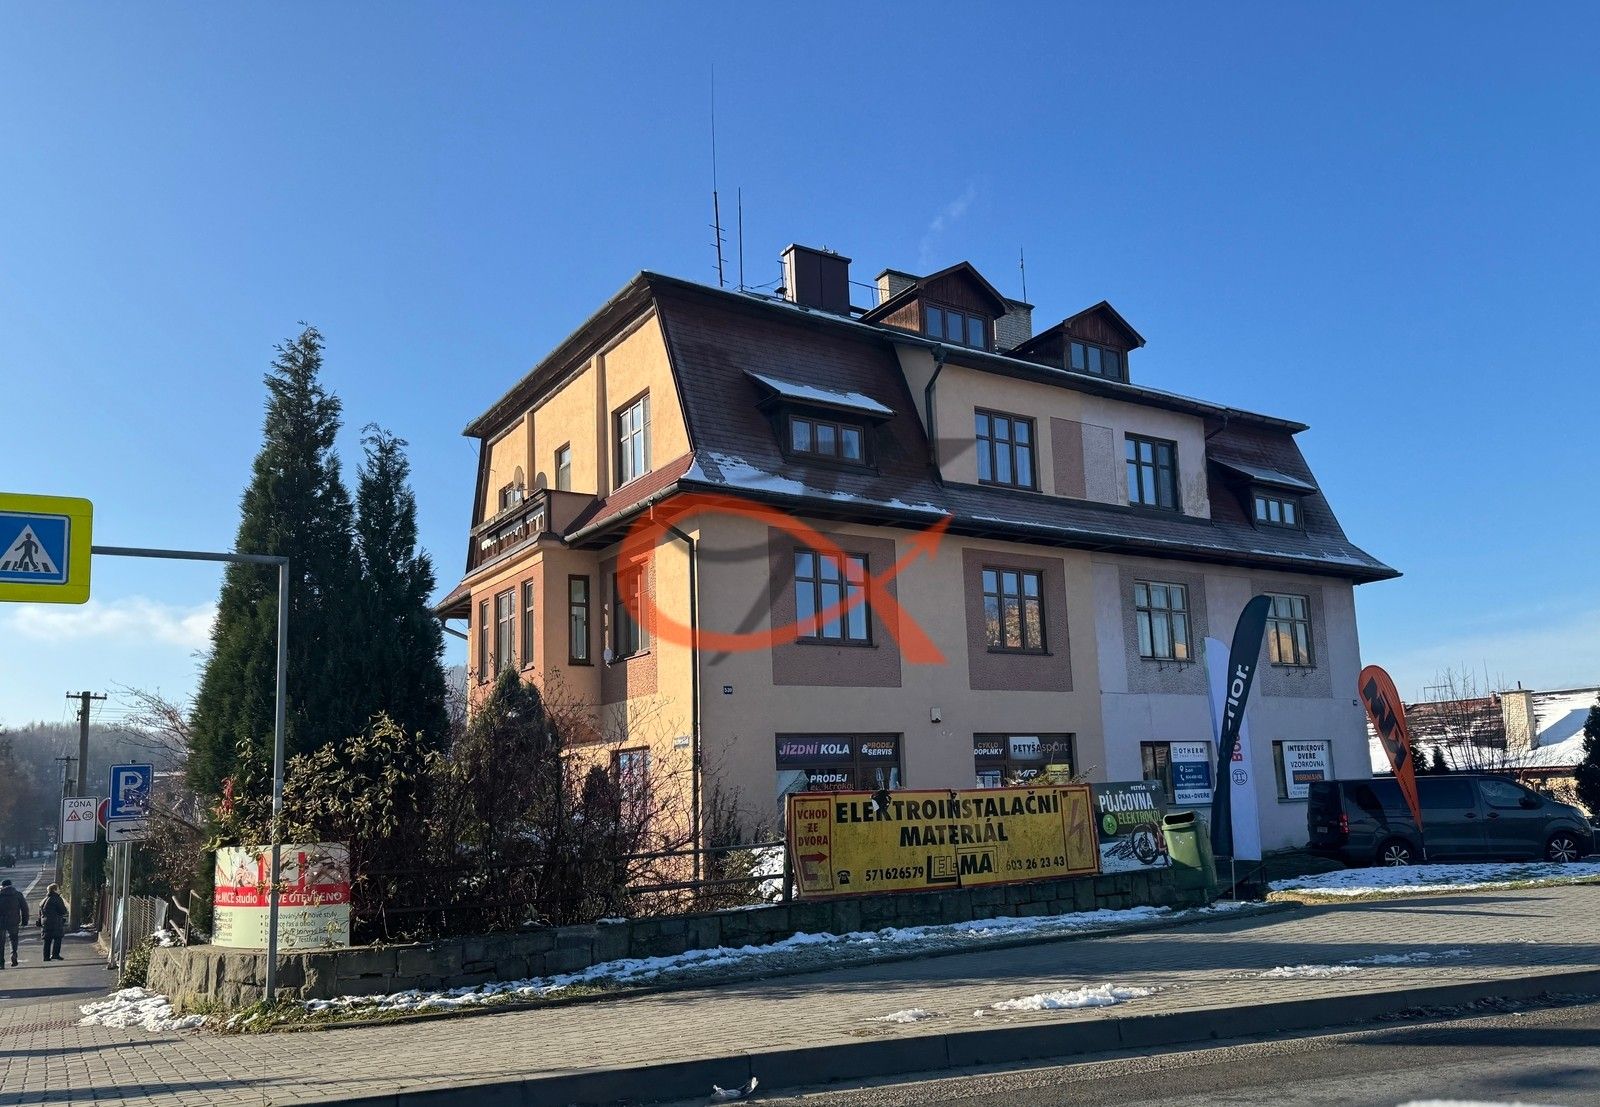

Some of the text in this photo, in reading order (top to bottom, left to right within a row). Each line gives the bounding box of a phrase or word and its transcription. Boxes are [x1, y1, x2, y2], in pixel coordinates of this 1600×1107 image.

[779, 741, 850, 755] JÍZDNÍ KOLA
[866, 741, 895, 749] PRODEJ
[977, 741, 999, 749] CYKLO
[1287, 742, 1325, 752] INTERIÉROVÉ
[867, 748, 893, 756] SERVIS
[1297, 750, 1317, 760] DVEŘE
[1290, 760, 1325, 768] VZORKOVNA
[810, 773, 848, 784] PRODEJ
[119, 771, 143, 801] P
[836, 791, 1059, 824] ELEKTROINSTALAČNÍ
[1098, 790, 1154, 813] PŮJČOVNA
[796, 808, 828, 820] VCHOD
[1117, 810, 1163, 825] ELEKTROKOL
[807, 822, 819, 833] ZE
[899, 818, 1009, 848] MATERIÁL
[798, 835, 829, 847] DVORA
[1005, 855, 1065, 871] 603 26 23 43
[865, 865, 924, 882] 571626579
[235, 892, 257, 904] studio
